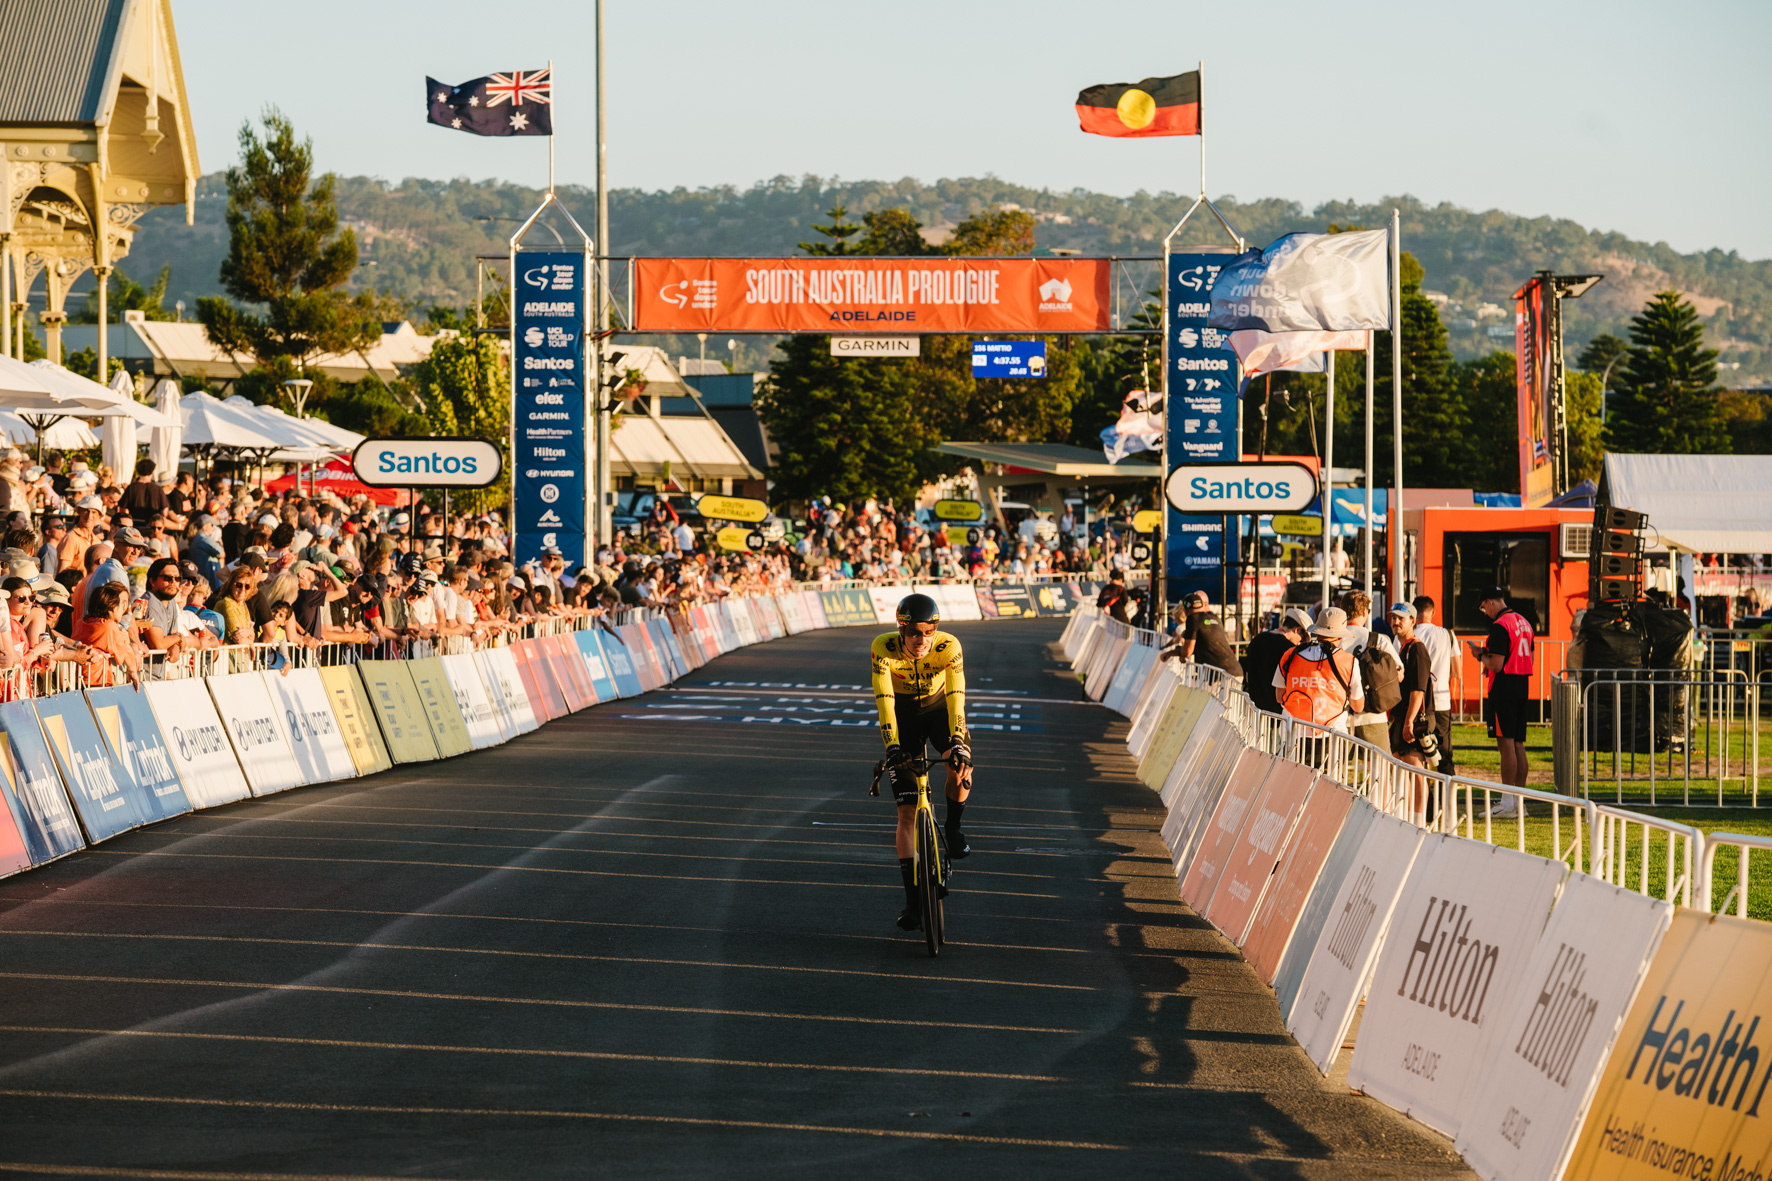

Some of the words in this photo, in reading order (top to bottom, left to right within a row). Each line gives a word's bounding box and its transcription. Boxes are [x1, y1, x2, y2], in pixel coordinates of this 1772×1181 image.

[746, 269, 804, 304] SOUTH
[808, 269, 904, 304] AUSTRALIA
[908, 270, 1000, 304] PROLOGUE
[524, 302, 575, 312] ADELAIDE
[1178, 302, 1210, 313] ADELA
[829, 311, 916, 322] ADELAIDE
[547, 326, 563, 334] UCI
[548, 340, 568, 348] TOUR
[838, 340, 910, 350] GARMIN
[524, 356, 574, 370] Santos
[1178, 357, 1228, 371] Santos
[535, 392, 564, 405] efex
[528, 412, 570, 420] GARMIN
[534, 447, 566, 456] Hilton
[1182, 442, 1223, 452] Vanguard
[379, 450, 478, 474] Santos
[540, 470, 574, 478] HYUNDAI
[1190, 476, 1290, 499] Santos
[1193, 557, 1220, 565] YAMAHA
[1292, 676, 1336, 691] PRESS
[298, 711, 335, 736] HYUNDAI
[242, 716, 280, 746] HYUNDAI
[184, 725, 226, 756] HYUNDAI
[126, 734, 175, 798] Ziptrak
[74, 744, 120, 812] Ziptrak
[1328, 864, 1378, 971] Hilton
[1398, 896, 1500, 1025] Hilton
[1515, 942, 1599, 1088] Hilton
[1599, 1113, 1645, 1160] Health
